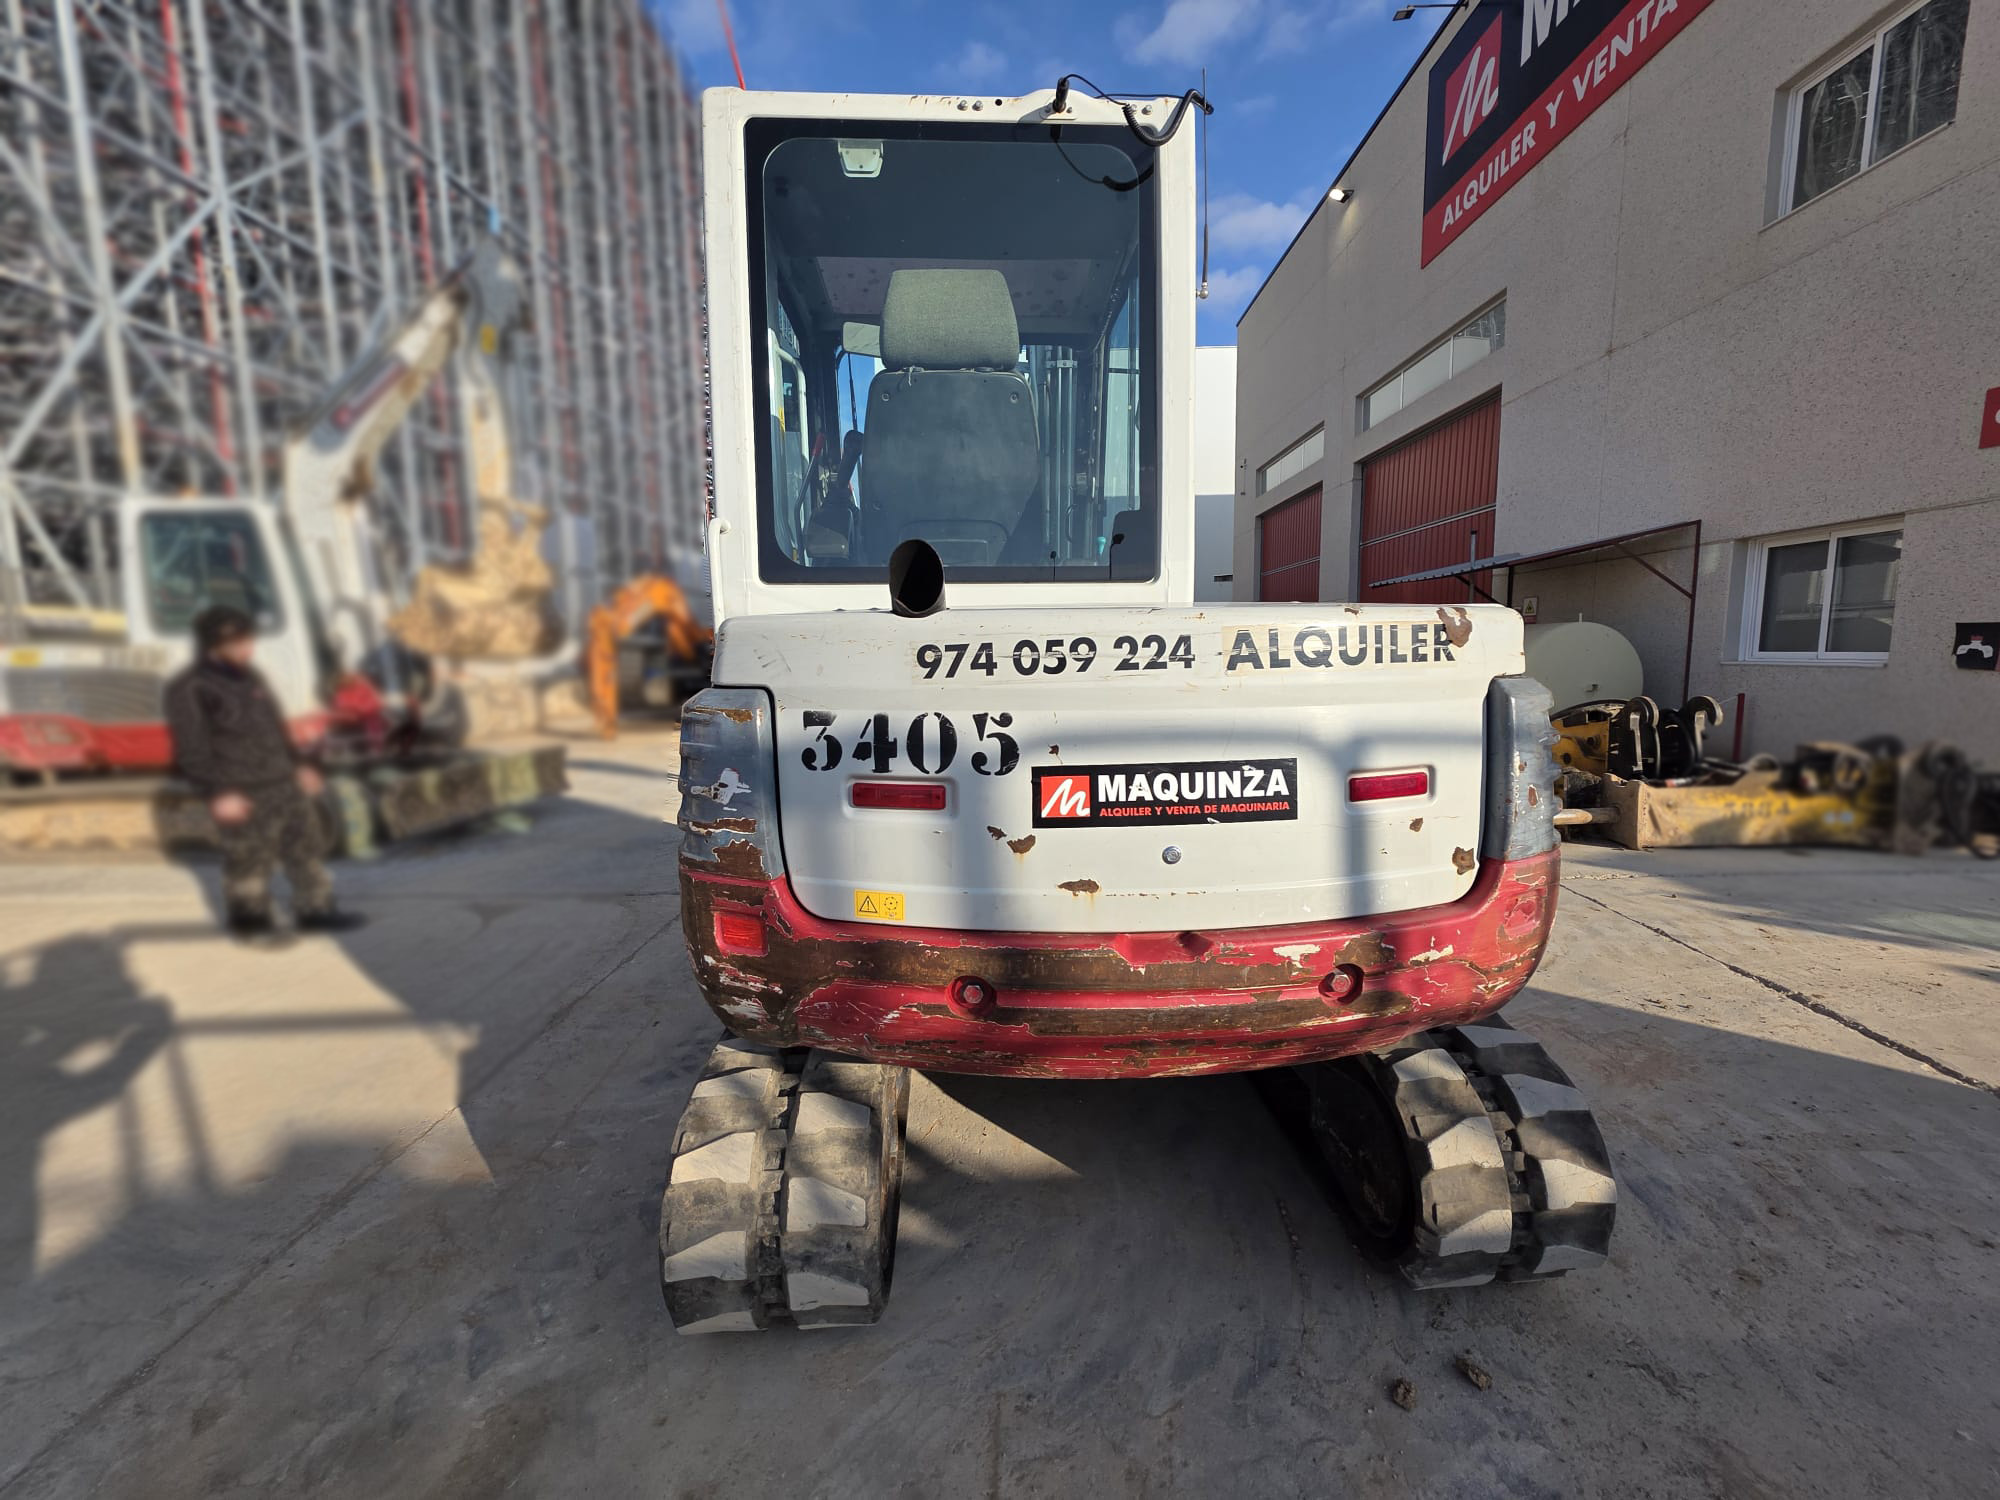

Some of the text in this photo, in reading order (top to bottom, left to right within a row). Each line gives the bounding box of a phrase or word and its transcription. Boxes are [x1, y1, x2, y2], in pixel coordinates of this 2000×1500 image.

[1441, 0, 1679, 235] ALQUILER Y VENTA
[916, 634, 1196, 680] 974 059 224
[1226, 623, 1456, 671] ALQUILER
[801, 710, 1020, 776] 3405
[1097, 768, 1290, 803] MAQUINZA
[1100, 800, 1290, 817] ALQUILER Y VENTA DE MAQUINARIA
